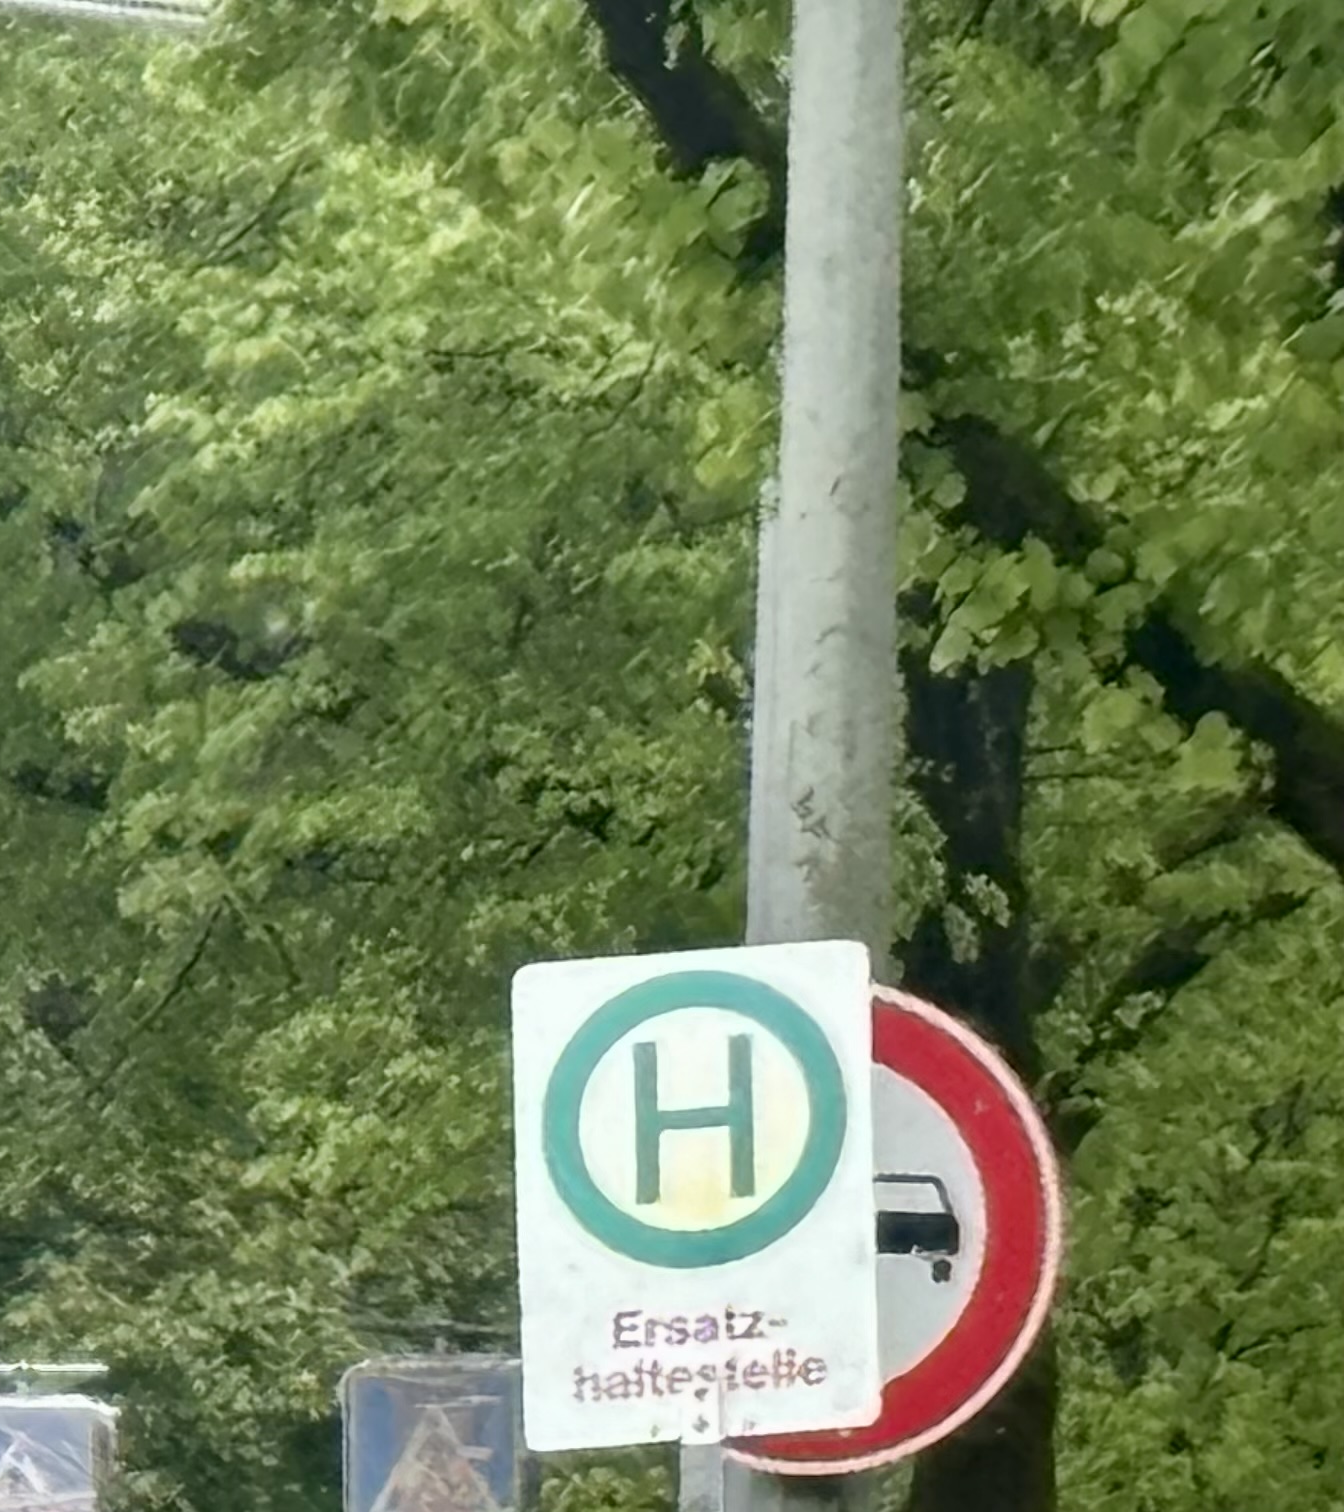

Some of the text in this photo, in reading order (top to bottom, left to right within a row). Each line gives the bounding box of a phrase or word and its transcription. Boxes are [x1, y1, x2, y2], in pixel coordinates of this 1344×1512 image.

[632, 1033, 756, 1206] H
[612, 1303, 788, 1349] Ersatz-
[572, 1348, 829, 1402] haltestelle
